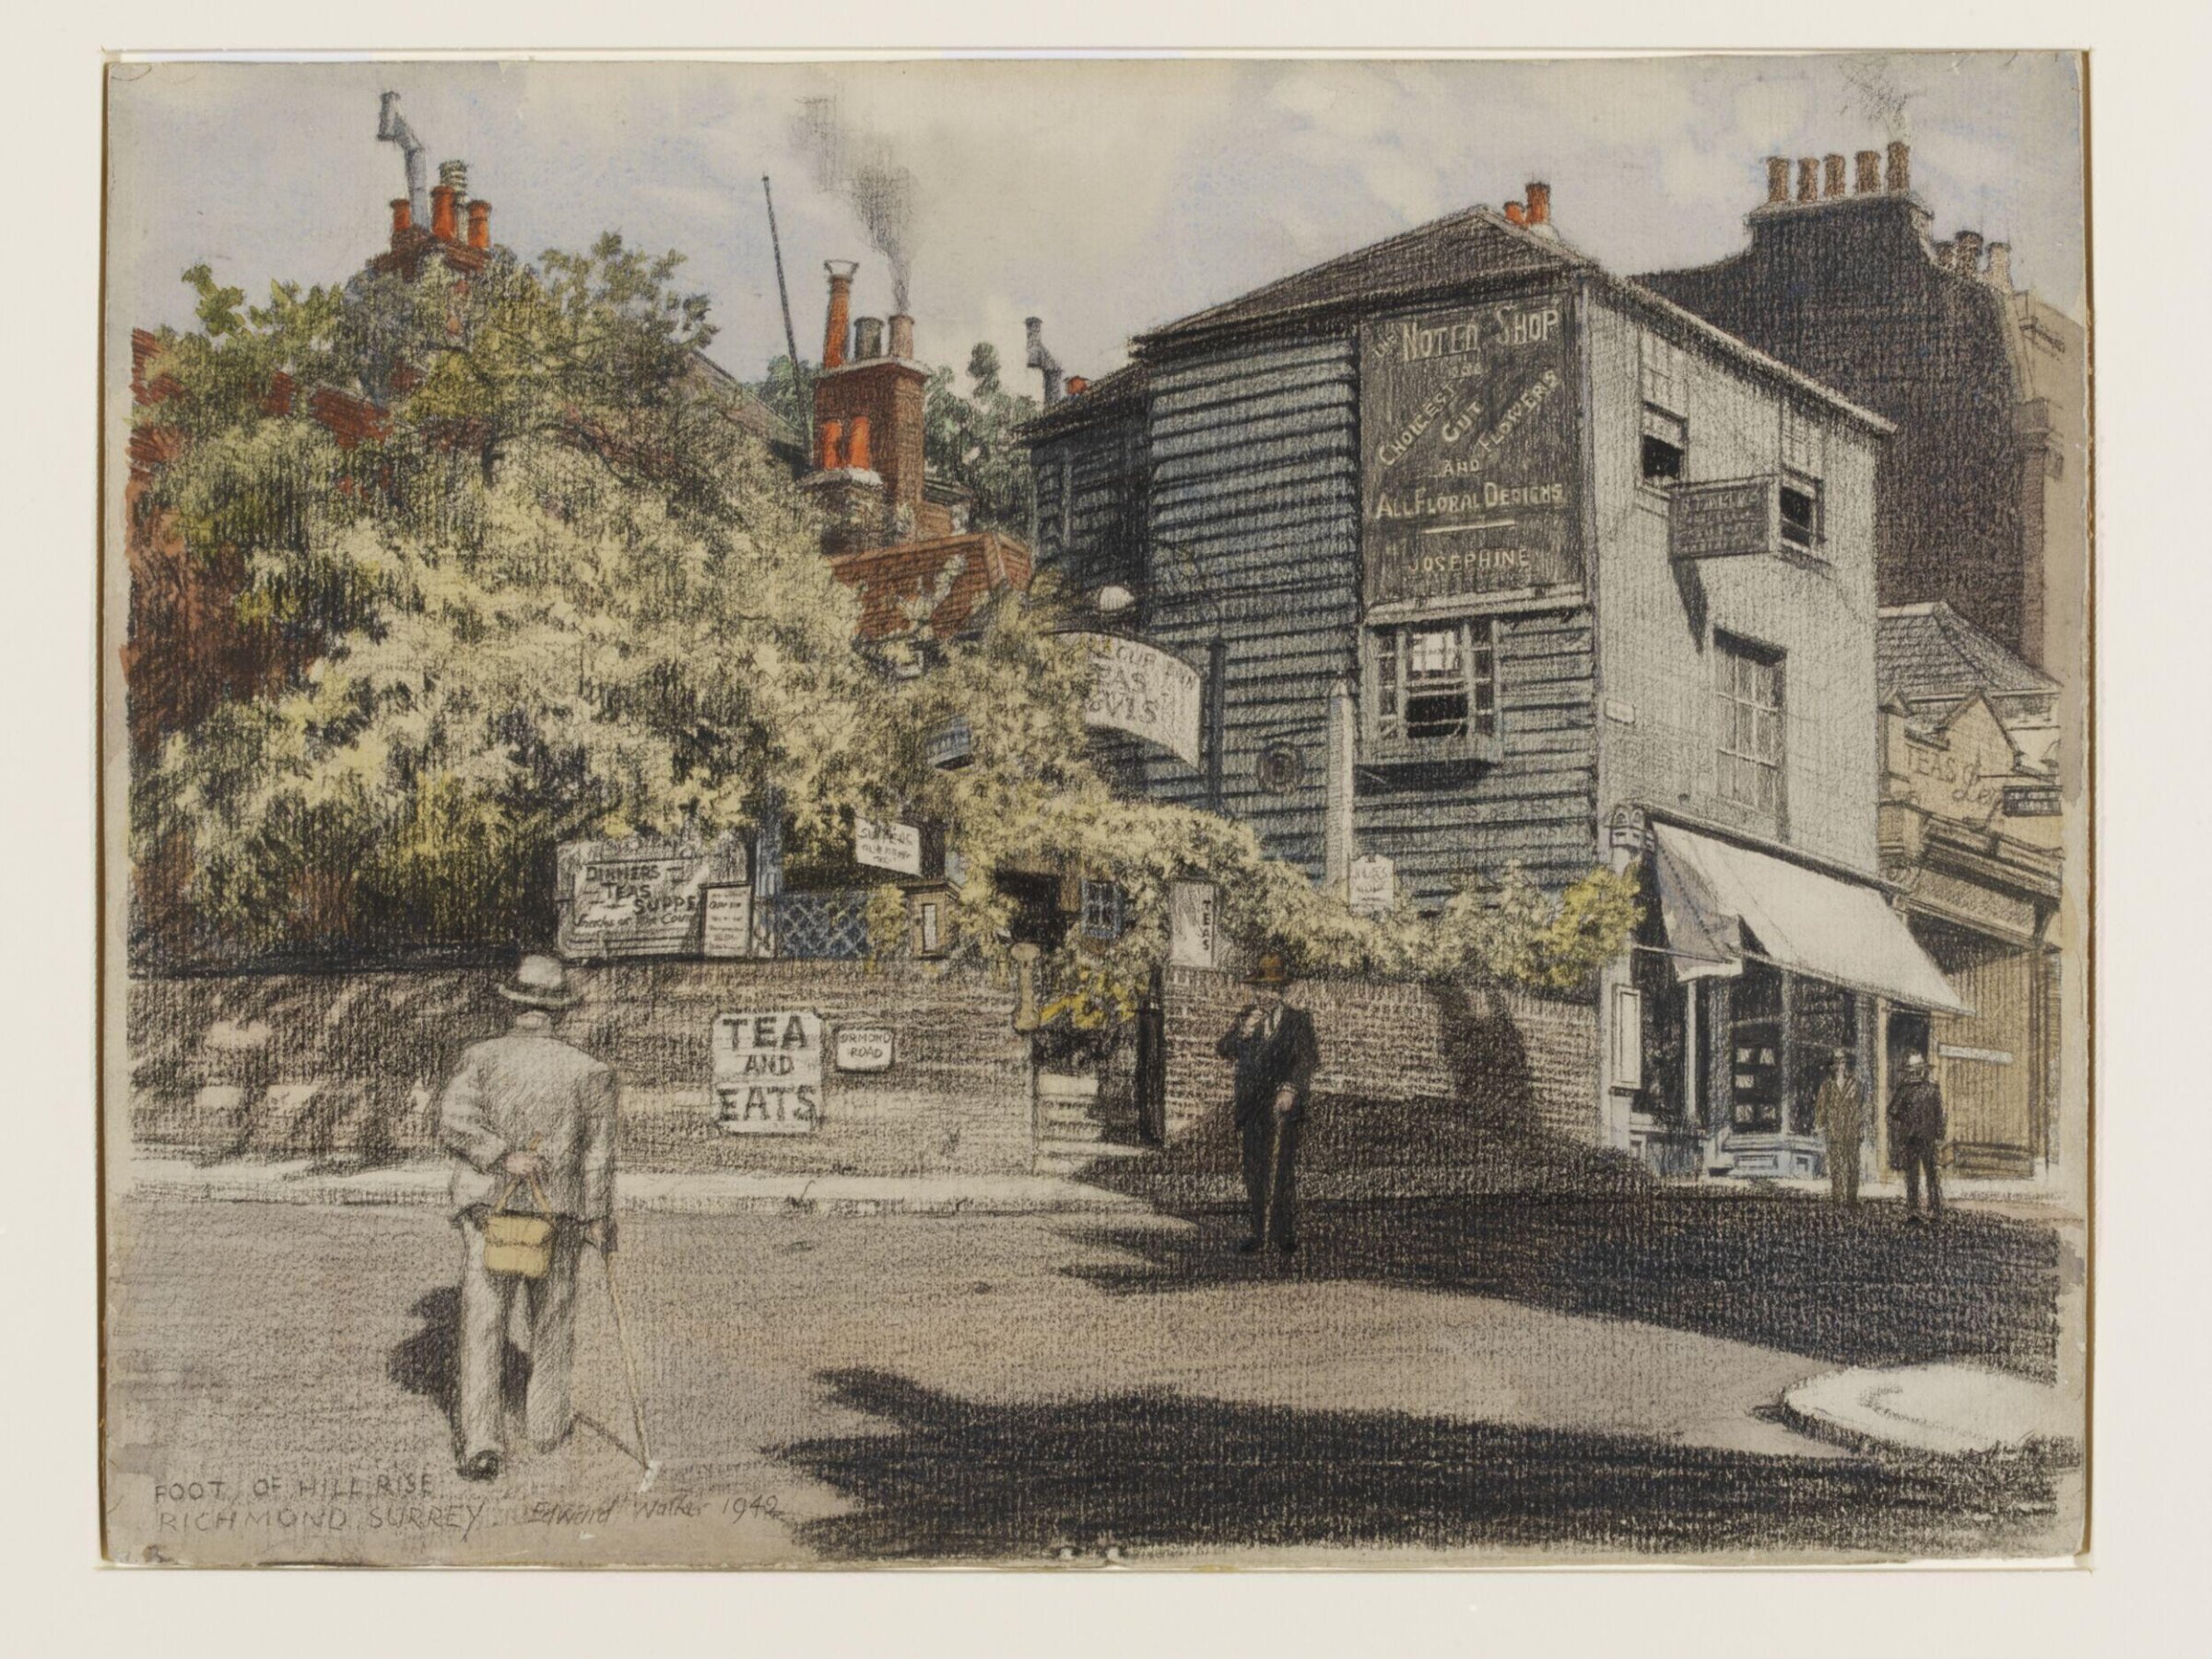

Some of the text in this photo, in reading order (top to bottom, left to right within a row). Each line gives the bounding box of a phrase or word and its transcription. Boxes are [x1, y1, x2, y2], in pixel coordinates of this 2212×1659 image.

[1402, 319, 1478, 361] NOTED
[1495, 304, 1559, 345] SHOP
[1378, 382, 1456, 466] CHOICEST
[1477, 369, 1559, 453] FLOWERS
[1441, 460, 1479, 478] AND
[1375, 492, 1412, 519] ALL
[1414, 486, 1480, 515] FLORAL
[1406, 546, 1532, 572] JOSEPHINE
[1202, 900, 1212, 951] TEAS
[722, 1016, 807, 1051] TEA
[840, 1032, 891, 1043] ORMOND
[744, 1054, 794, 1077] AND
[850, 1046, 883, 1058] ROAD
[717, 1085, 818, 1122] EATS
[155, 1474, 434, 1502] FOOT OF HILL RISE
[159, 1507, 347, 1532] RICHMOND
